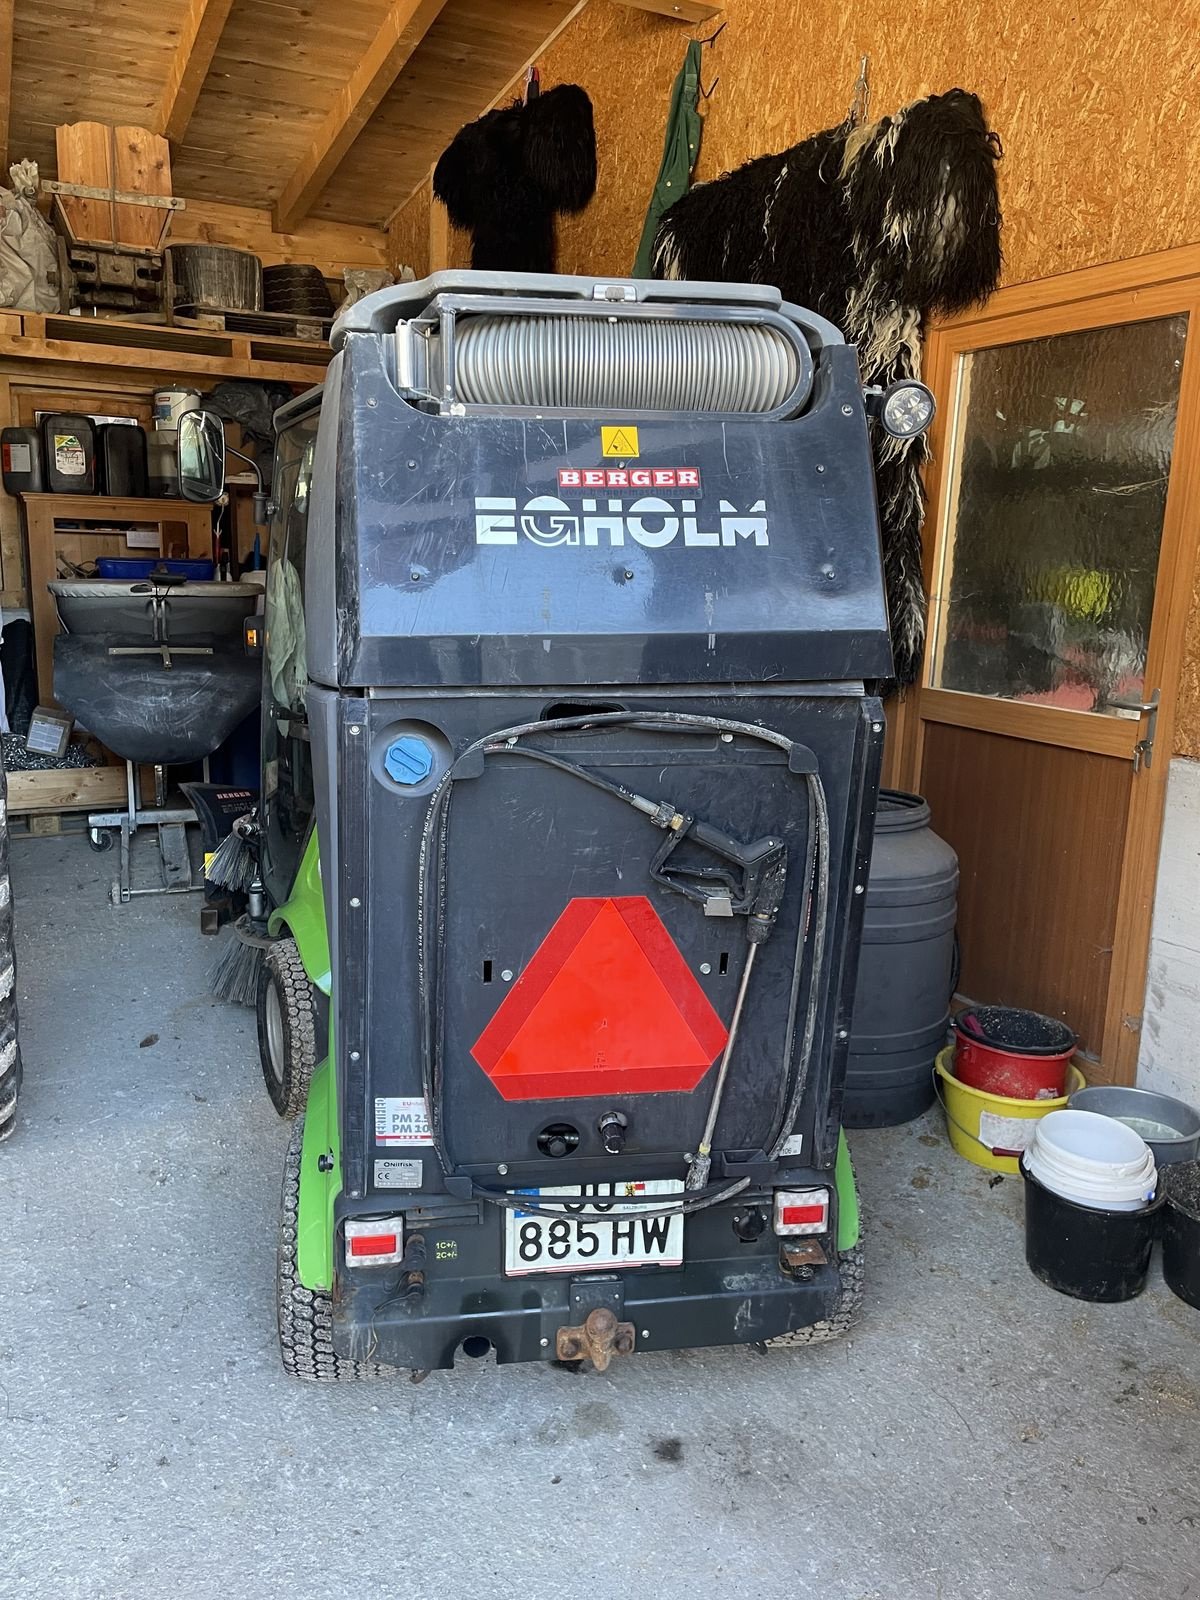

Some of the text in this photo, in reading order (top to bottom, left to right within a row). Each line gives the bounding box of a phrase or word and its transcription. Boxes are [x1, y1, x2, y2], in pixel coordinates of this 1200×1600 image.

[560, 471, 698, 485] BERGER
[474, 496, 769, 548] EGHOLM
[392, 1113, 412, 1123] PM
[392, 1124, 412, 1133] PM
[519, 1216, 671, 1261] 885 HW
